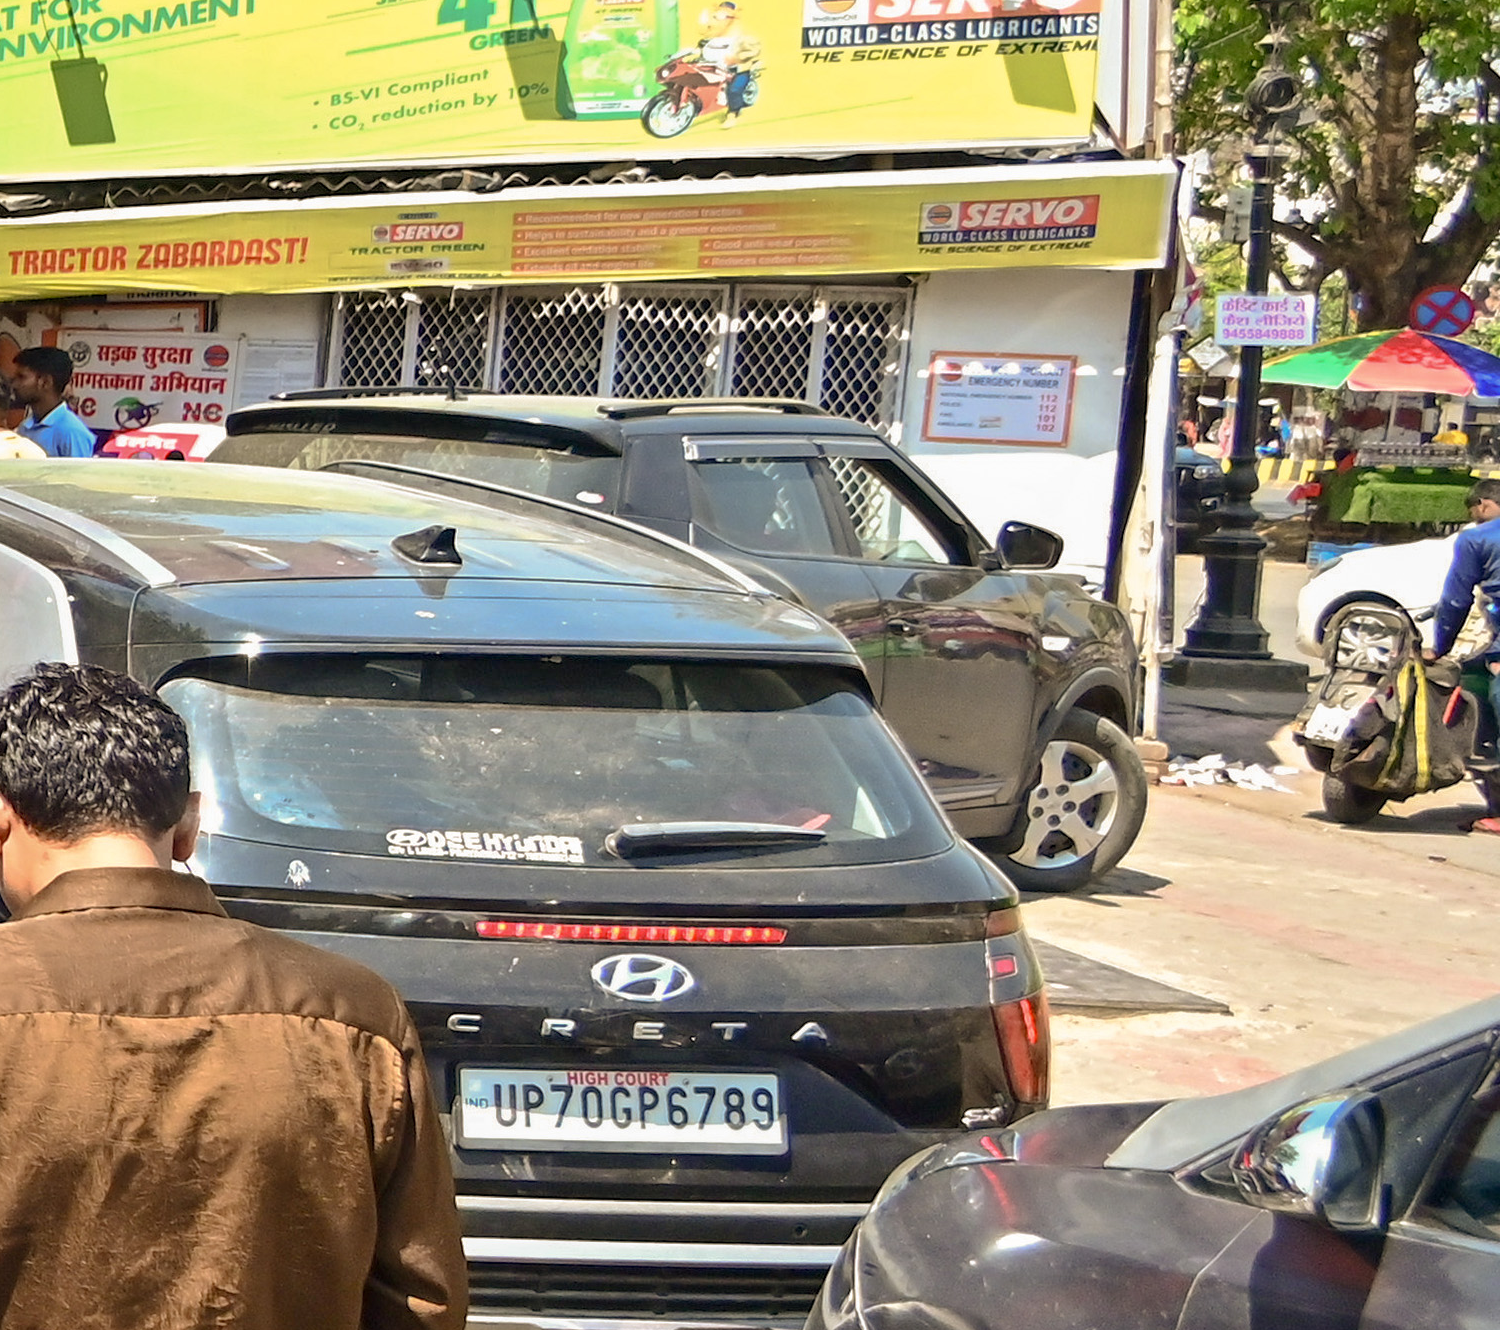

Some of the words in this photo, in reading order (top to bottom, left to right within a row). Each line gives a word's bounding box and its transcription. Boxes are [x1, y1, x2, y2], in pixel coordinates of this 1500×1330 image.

[467, 22, 551, 53] GREEN
[806, 20, 958, 48] WORLD-CLASS
[963, 12, 1100, 40] LUBRICANTS
[801, 50, 845, 65] THE
[849, 45, 950, 63] SCIENCE
[955, 43, 988, 59] OF
[329, 85, 377, 110] BS-VI
[383, 66, 491, 103] Compliant
[370, 94, 468, 126] reduction
[471, 90, 499, 116] by
[525, 211, 600, 224] Recommended
[960, 198, 1085, 229] SERVO
[392, 223, 462, 242] SERVO
[525, 229, 554, 243] Helps
[637, 225, 659, 236] and
[921, 229, 1008, 244] WORLD-CLASS
[1012, 226, 1090, 241] LUBRICANTS
[8, 241, 127, 278] TRACTOR
[135, 235, 310, 271] ZABARDAST!
[347, 244, 428, 256] TRACTOR
[524, 245, 569, 258] Excellent
[712, 239, 742, 251] Good
[918, 245, 943, 254] THE
[946, 243, 1002, 254] SCIENCE
[1028, 240, 1094, 252] EXTREME
[96, 344, 138, 367] सड़क
[142, 343, 194, 369] सुरक्षा
[150, 371, 228, 395] अभियान
[967, 376, 1021, 389] EMERGENCY
[1022, 377, 1060, 389] NUMBER
[1038, 403, 1058, 413] 112
[1039, 393, 1059, 404] 112
[1037, 413, 1057, 423] 101
[1035, 423, 1056, 433] 102
[426, 829, 484, 851] DEE
[446, 1012, 829, 1046] CRETA
[566, 1070, 608, 1089] HIGH
[610, 1070, 672, 1089] COURT
[491, 1081, 775, 1136] UP70GP6789
